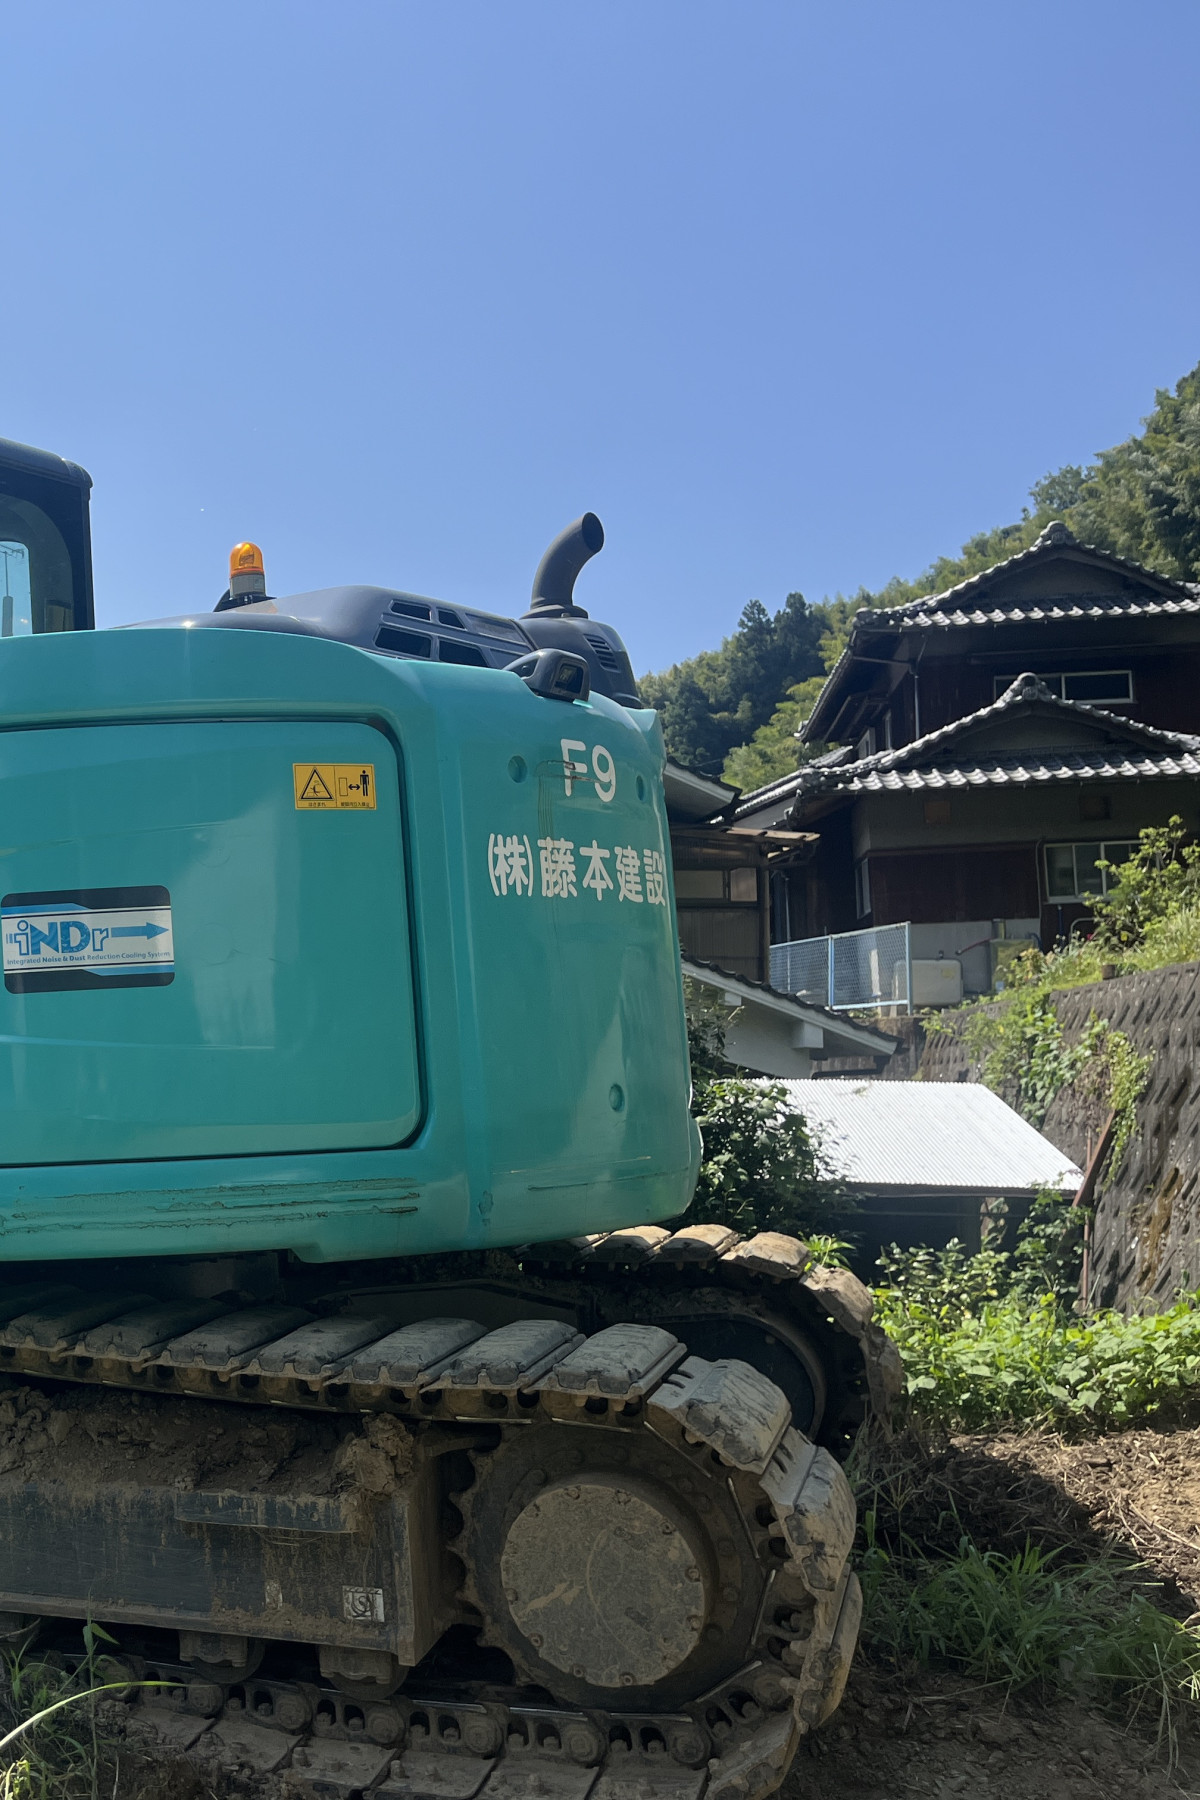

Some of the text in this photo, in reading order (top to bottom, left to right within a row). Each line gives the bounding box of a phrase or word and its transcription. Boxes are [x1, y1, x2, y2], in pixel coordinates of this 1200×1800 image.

[560, 738, 617, 803] F9
[7, 957, 41, 966] Integrated
[87, 953, 120, 961] Reduction
[121, 952, 146, 960] Cooling
[147, 951, 171, 960] System
